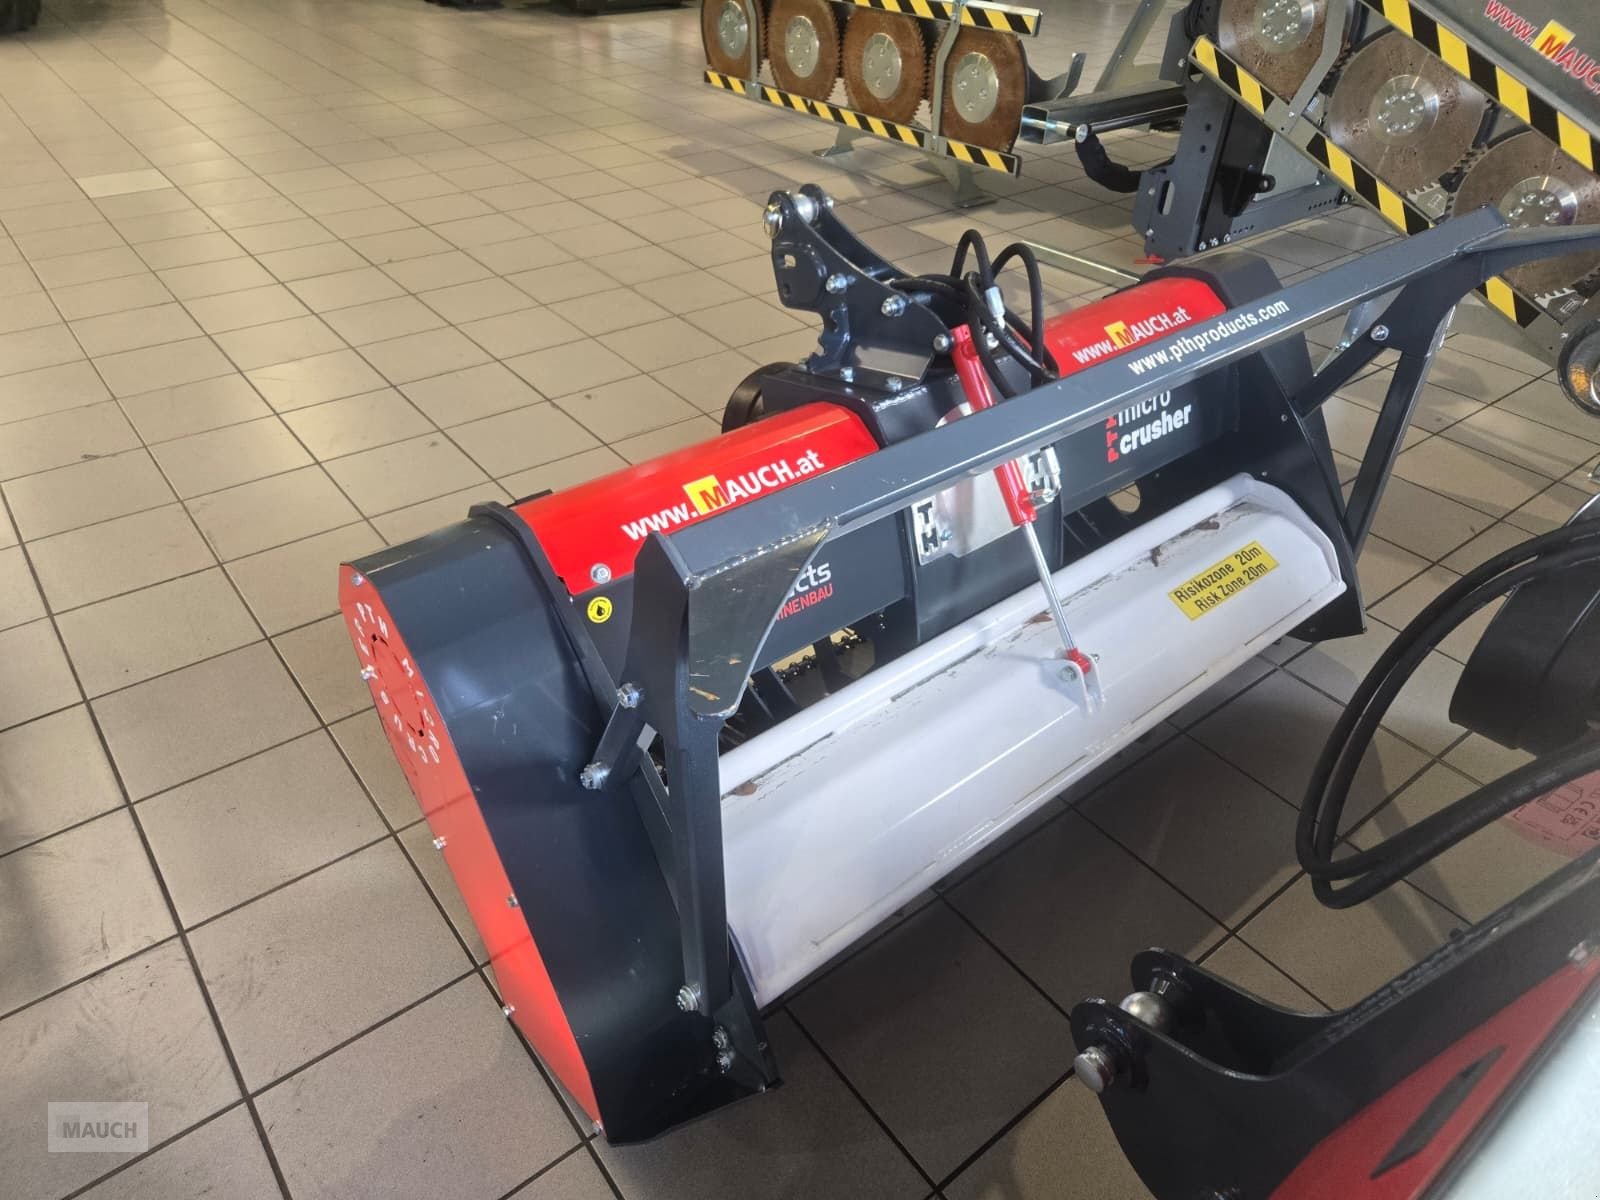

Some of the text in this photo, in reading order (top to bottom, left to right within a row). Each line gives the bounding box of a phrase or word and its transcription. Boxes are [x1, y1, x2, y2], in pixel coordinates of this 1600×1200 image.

[1483, 0, 1600, 96] www.MAUC
[1072, 306, 1192, 365] www.MAUCH.at
[1127, 300, 1291, 376] www.pthproducts.com
[1119, 404, 1192, 455] crusher
[621, 449, 825, 541] www.MAUCH.at
[787, 562, 832, 599] cts
[1174, 546, 1262, 604] Risikozone 20m
[1194, 562, 1268, 611] Risk Zone 20m
